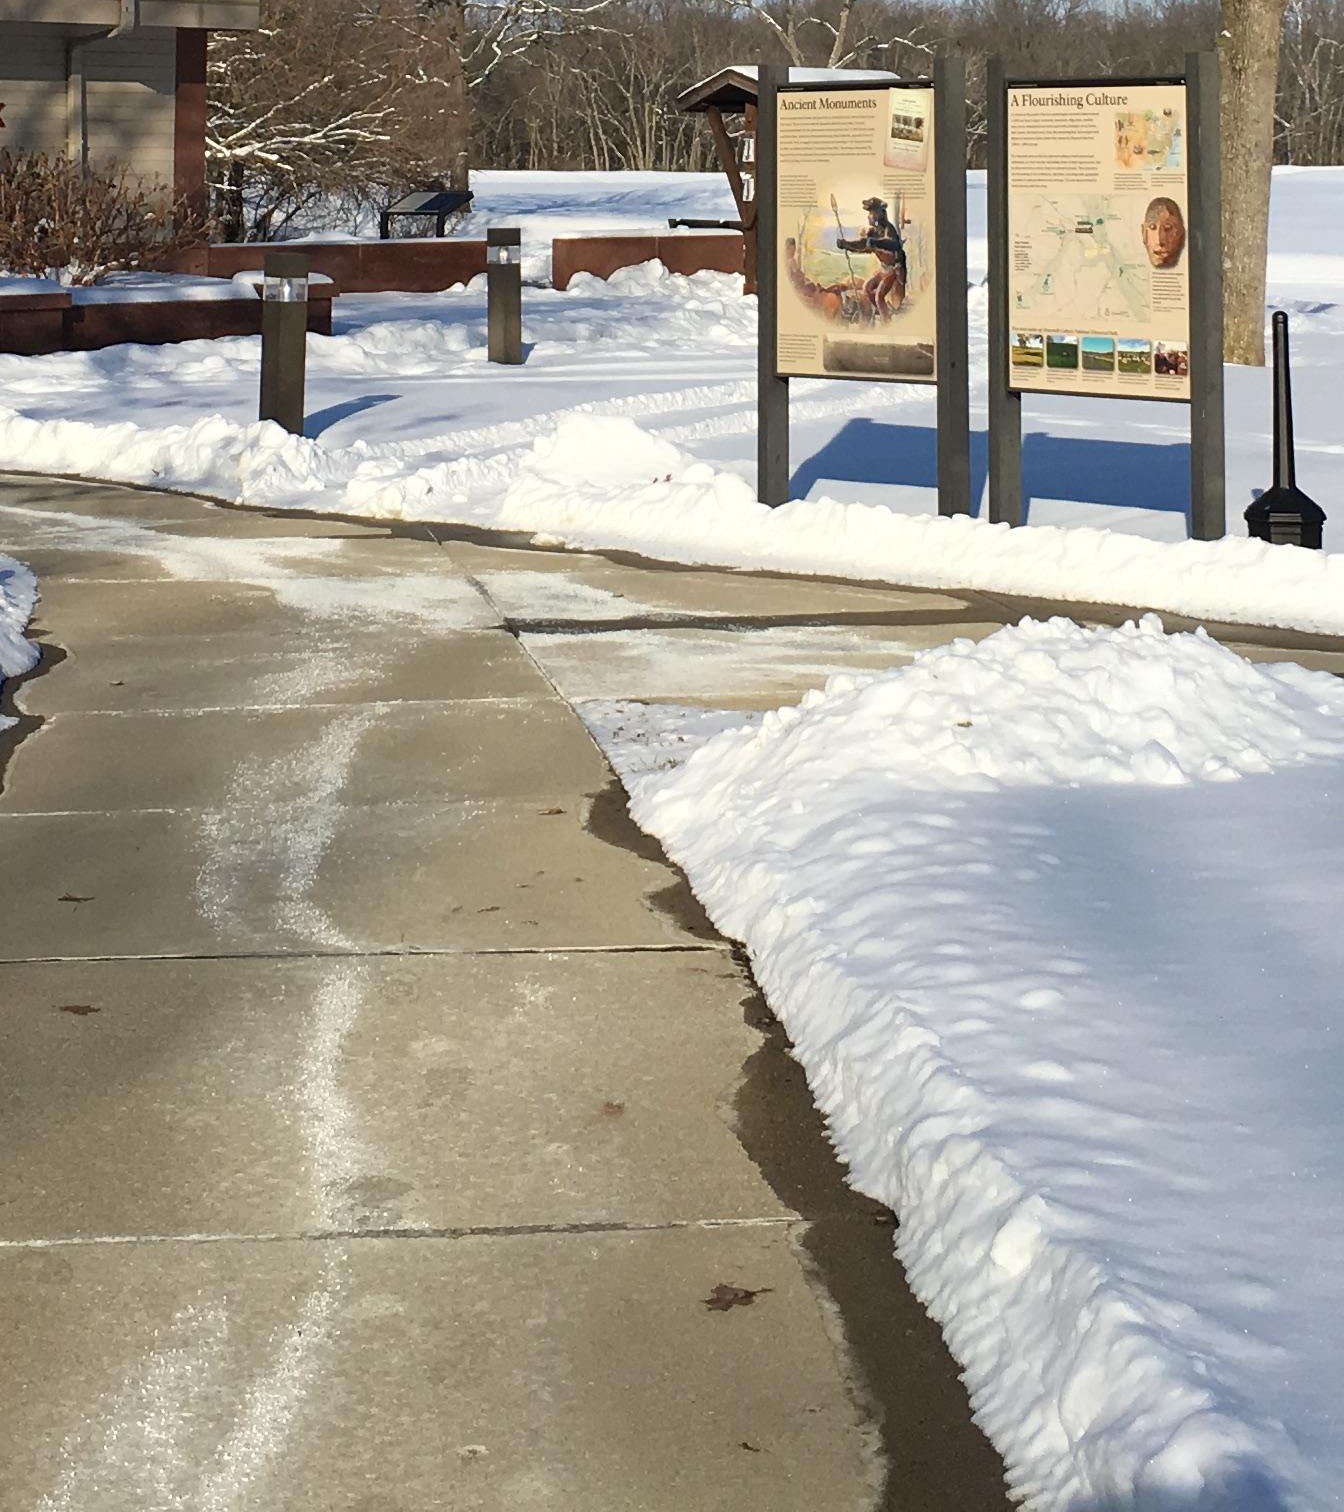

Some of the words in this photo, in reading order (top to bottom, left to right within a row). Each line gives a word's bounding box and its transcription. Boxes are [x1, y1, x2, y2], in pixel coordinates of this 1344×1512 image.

[780, 98, 816, 111] Ancient
[819, 97, 877, 110] Monuments
[1010, 94, 1019, 107] A
[1021, 93, 1084, 109] Flourishing
[1085, 93, 1128, 106] Culture
